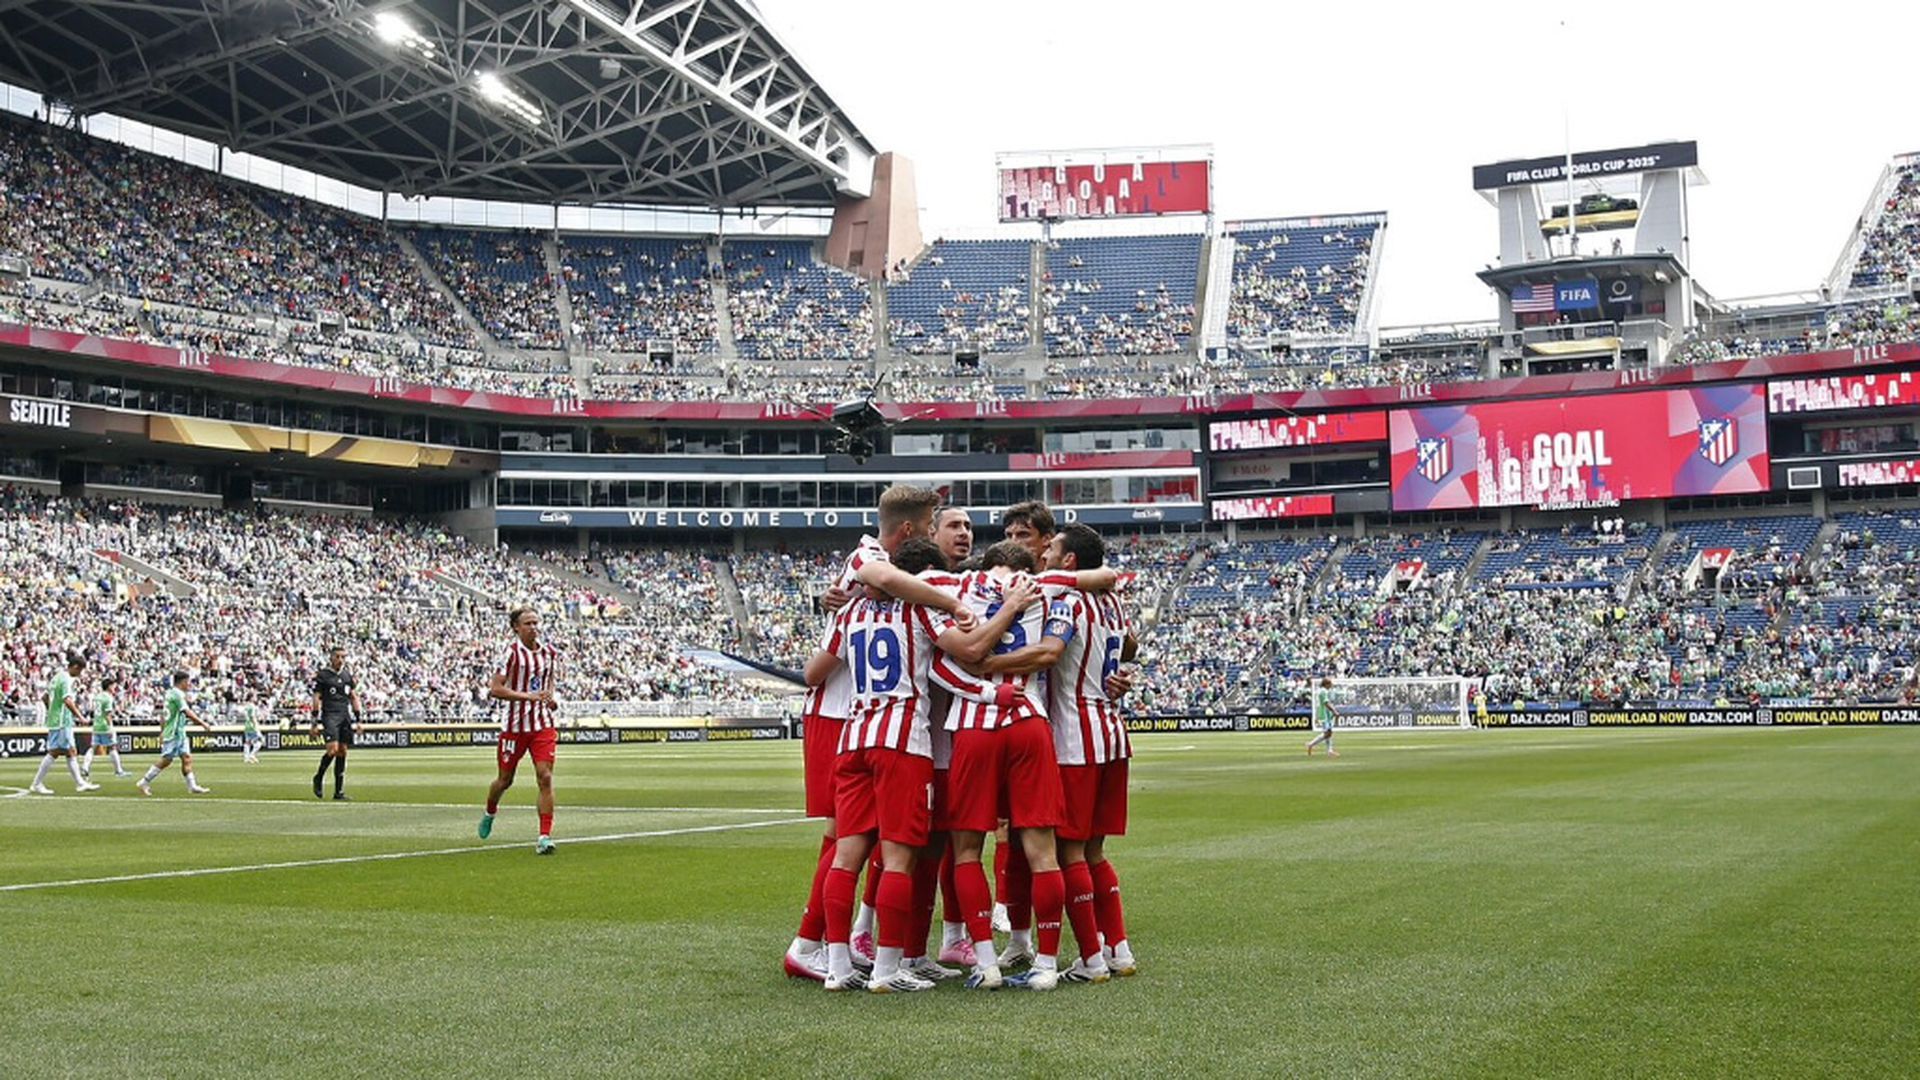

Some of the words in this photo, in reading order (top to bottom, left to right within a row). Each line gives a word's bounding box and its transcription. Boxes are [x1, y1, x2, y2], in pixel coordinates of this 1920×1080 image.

[1506, 171, 1529, 183] FIFA
[1531, 167, 1559, 180] CLUB
[1602, 159, 1626, 171] CUP
[1560, 288, 1591, 301] FIFA
[10, 399, 71, 428] SEATTLE
[1533, 429, 1612, 468] GOAL
[628, 511, 780, 526] WELCOME
[803, 511, 838, 526] TO
[850, 627, 902, 694] 19
[1250, 717, 1309, 729] DOWNLOAD
[1338, 715, 1394, 727] DAZN.COM
[1417, 714, 1462, 725] DOWNLO
[1510, 713, 1570, 724] DAZN.COM
[1590, 713, 1656, 724] DOWNLOAD
[1659, 712, 1687, 723] NOW
[1689, 712, 1753, 723] DAZN.COM
[1776, 711, 1847, 723] DOWNLOAD
[1850, 710, 1879, 722] NOW
[1882, 710, 1920, 722] DAZN.
[1126, 720, 1152, 730] LOAD
[1155, 719, 1178, 730] NOW
[1180, 718, 1233, 730] DAZN.COM
[281, 734, 325, 746] DOWNLOA
[410, 732, 453, 744] DOWNLOAD
[472, 730, 499, 742] DAZN.C
[8, 739, 35, 753] CUP
